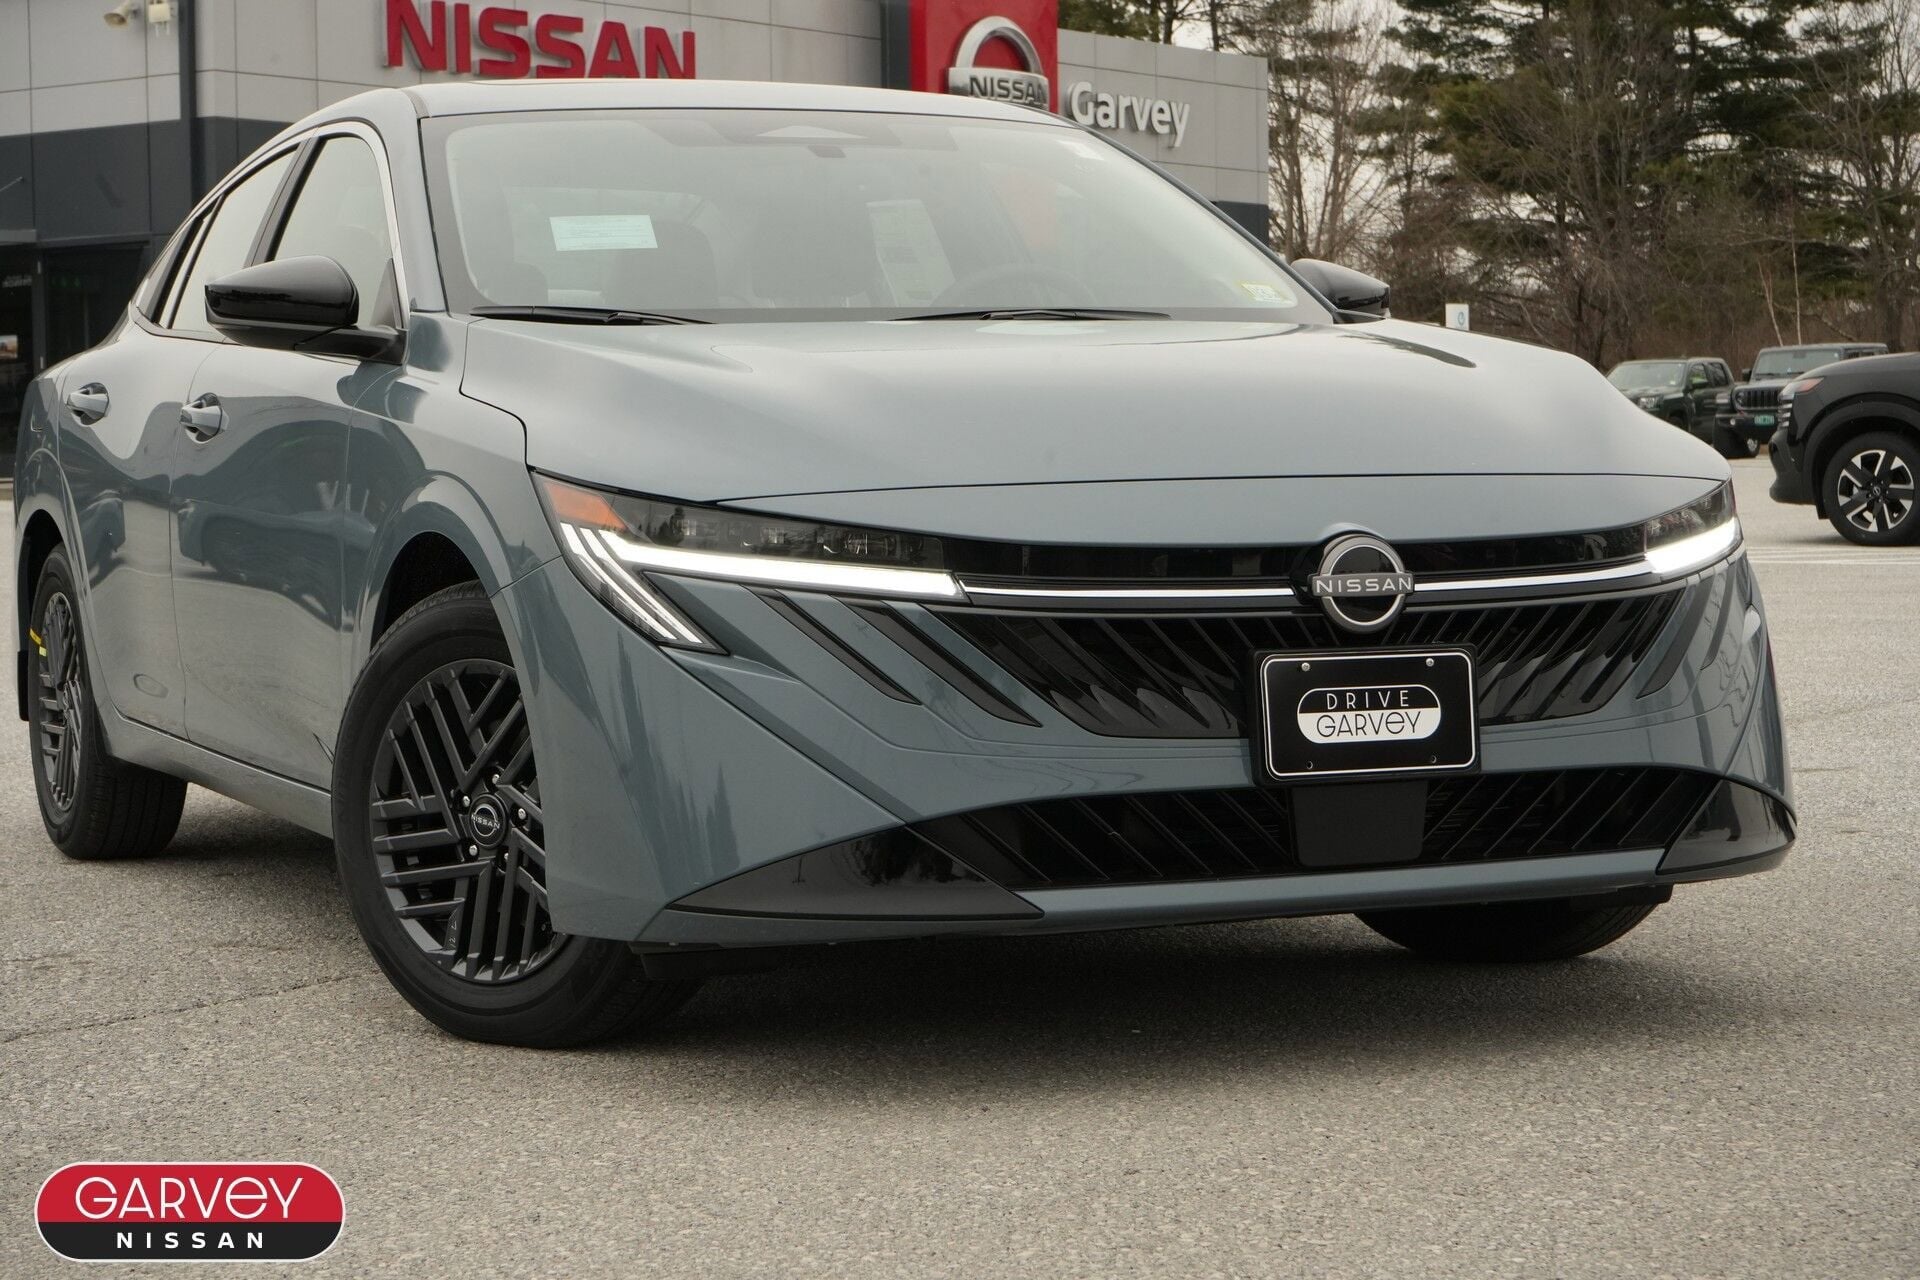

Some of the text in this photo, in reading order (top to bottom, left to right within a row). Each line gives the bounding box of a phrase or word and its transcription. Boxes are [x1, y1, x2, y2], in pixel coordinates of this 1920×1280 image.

[386, 0, 696, 79] NISSAN
[969, 75, 1048, 105] NISSAN
[1069, 81, 1190, 148] Garvey
[1316, 577, 1412, 593] NISSAN
[1326, 690, 1410, 710] DRIVE
